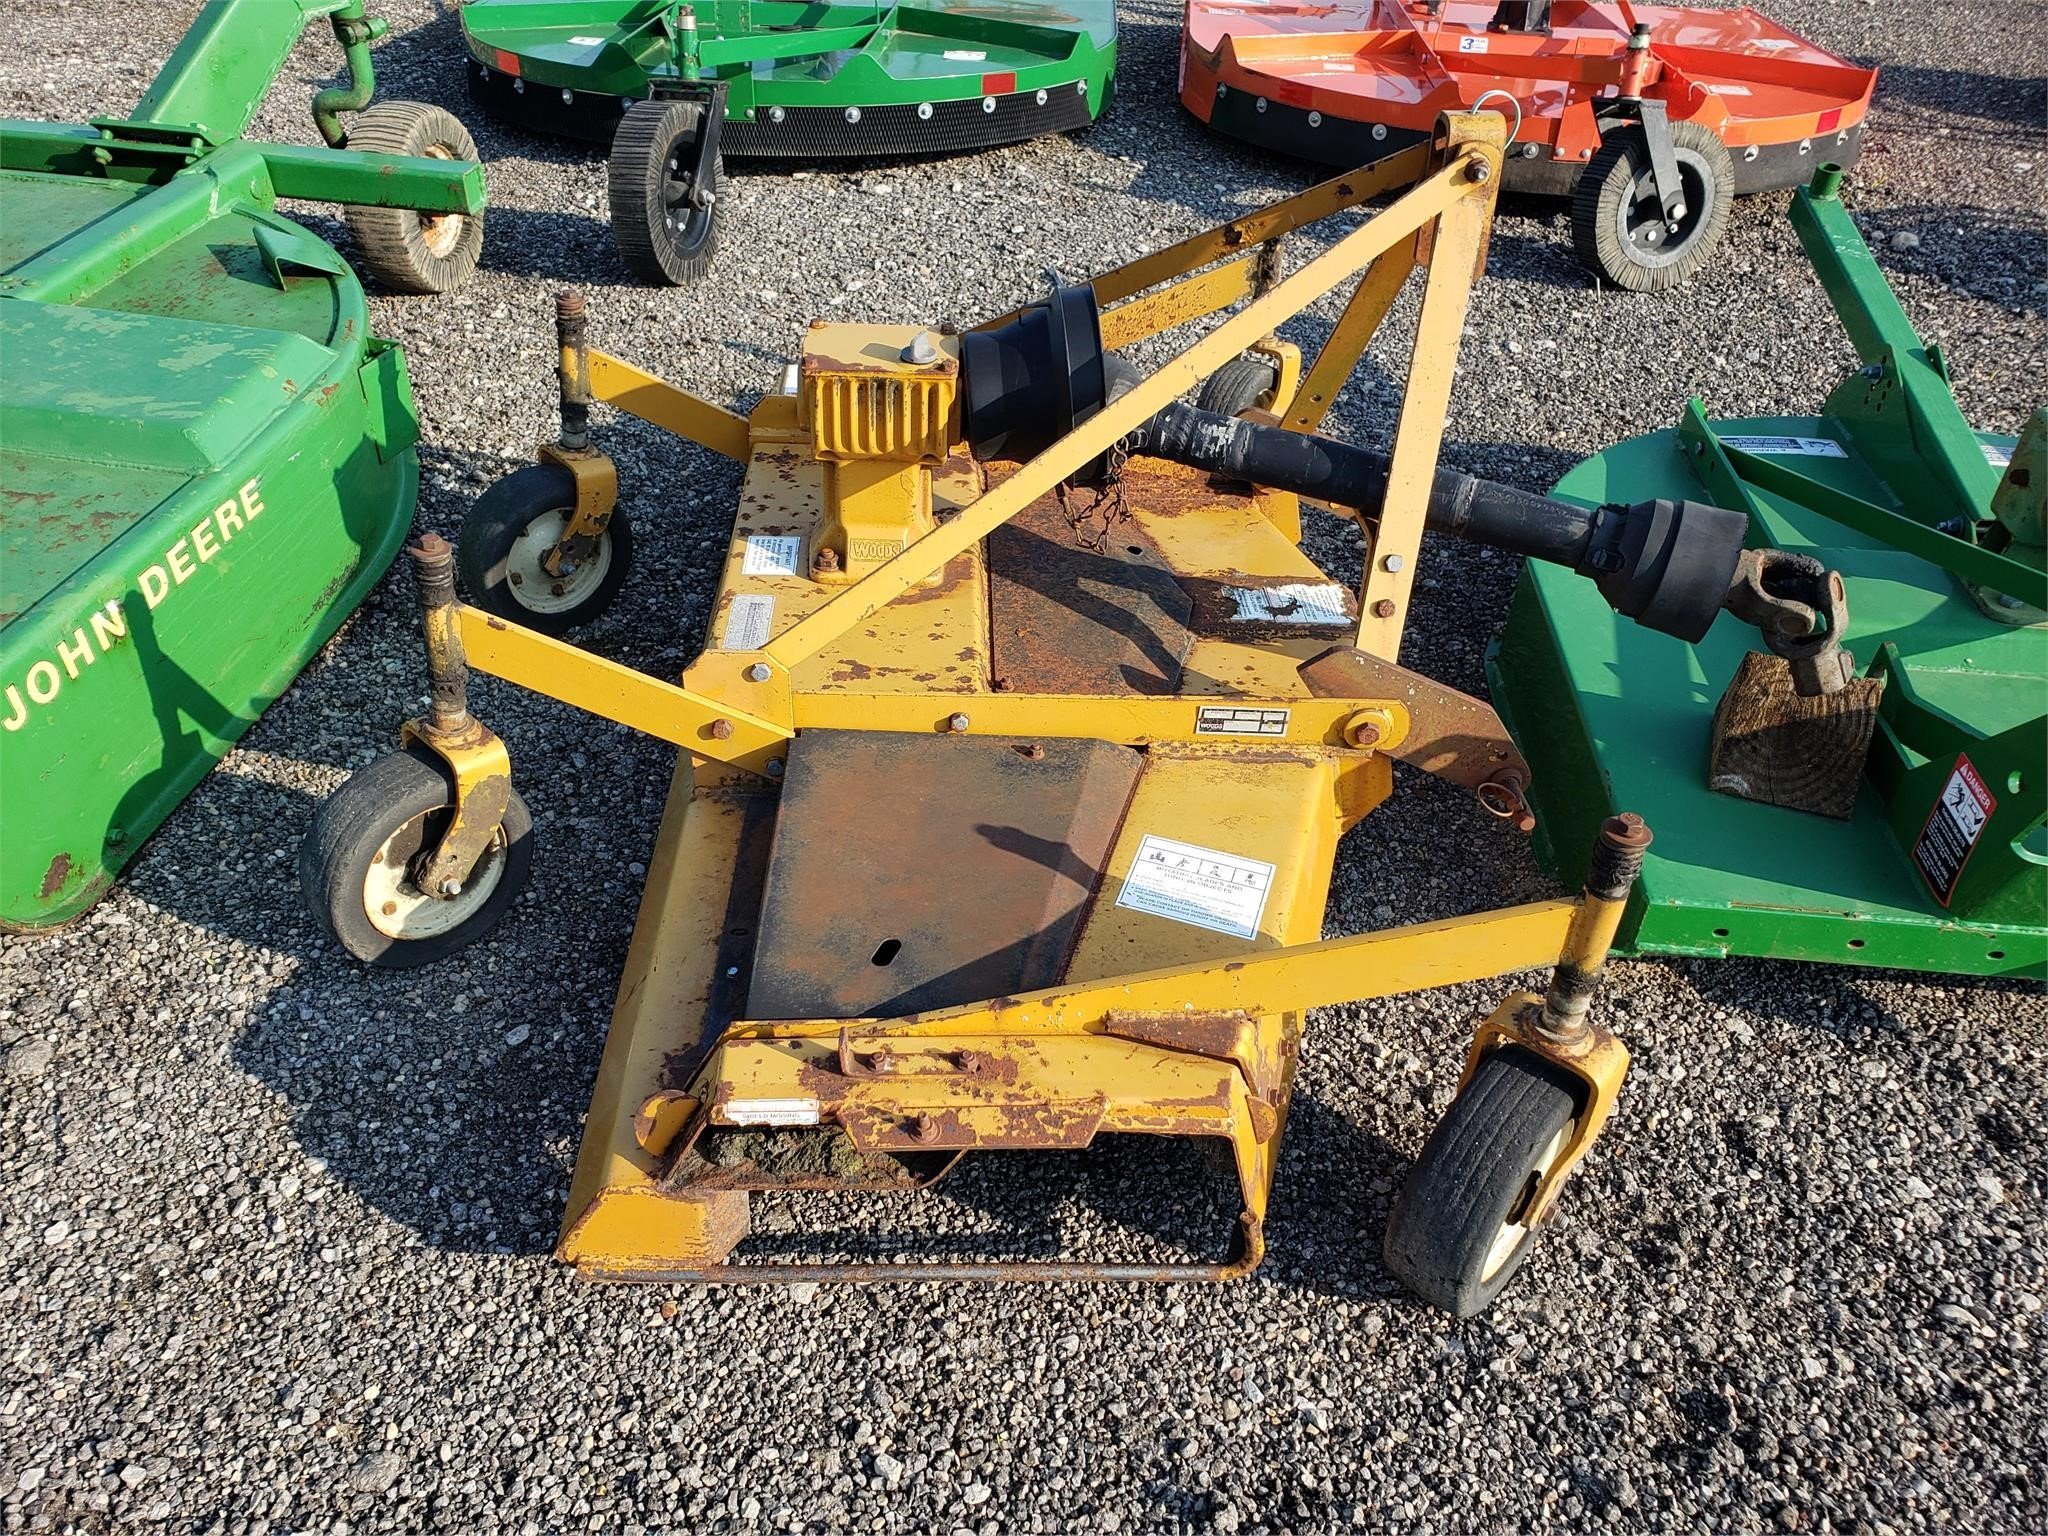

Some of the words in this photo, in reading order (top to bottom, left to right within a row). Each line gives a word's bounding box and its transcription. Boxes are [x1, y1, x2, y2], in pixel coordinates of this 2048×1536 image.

[1462, 38, 1474, 49] 3
[852, 541, 902, 558] WOODS
[1, 598, 127, 732] JOHN
[136, 477, 266, 611] DEERE
[1966, 771, 1991, 810] DANGER
